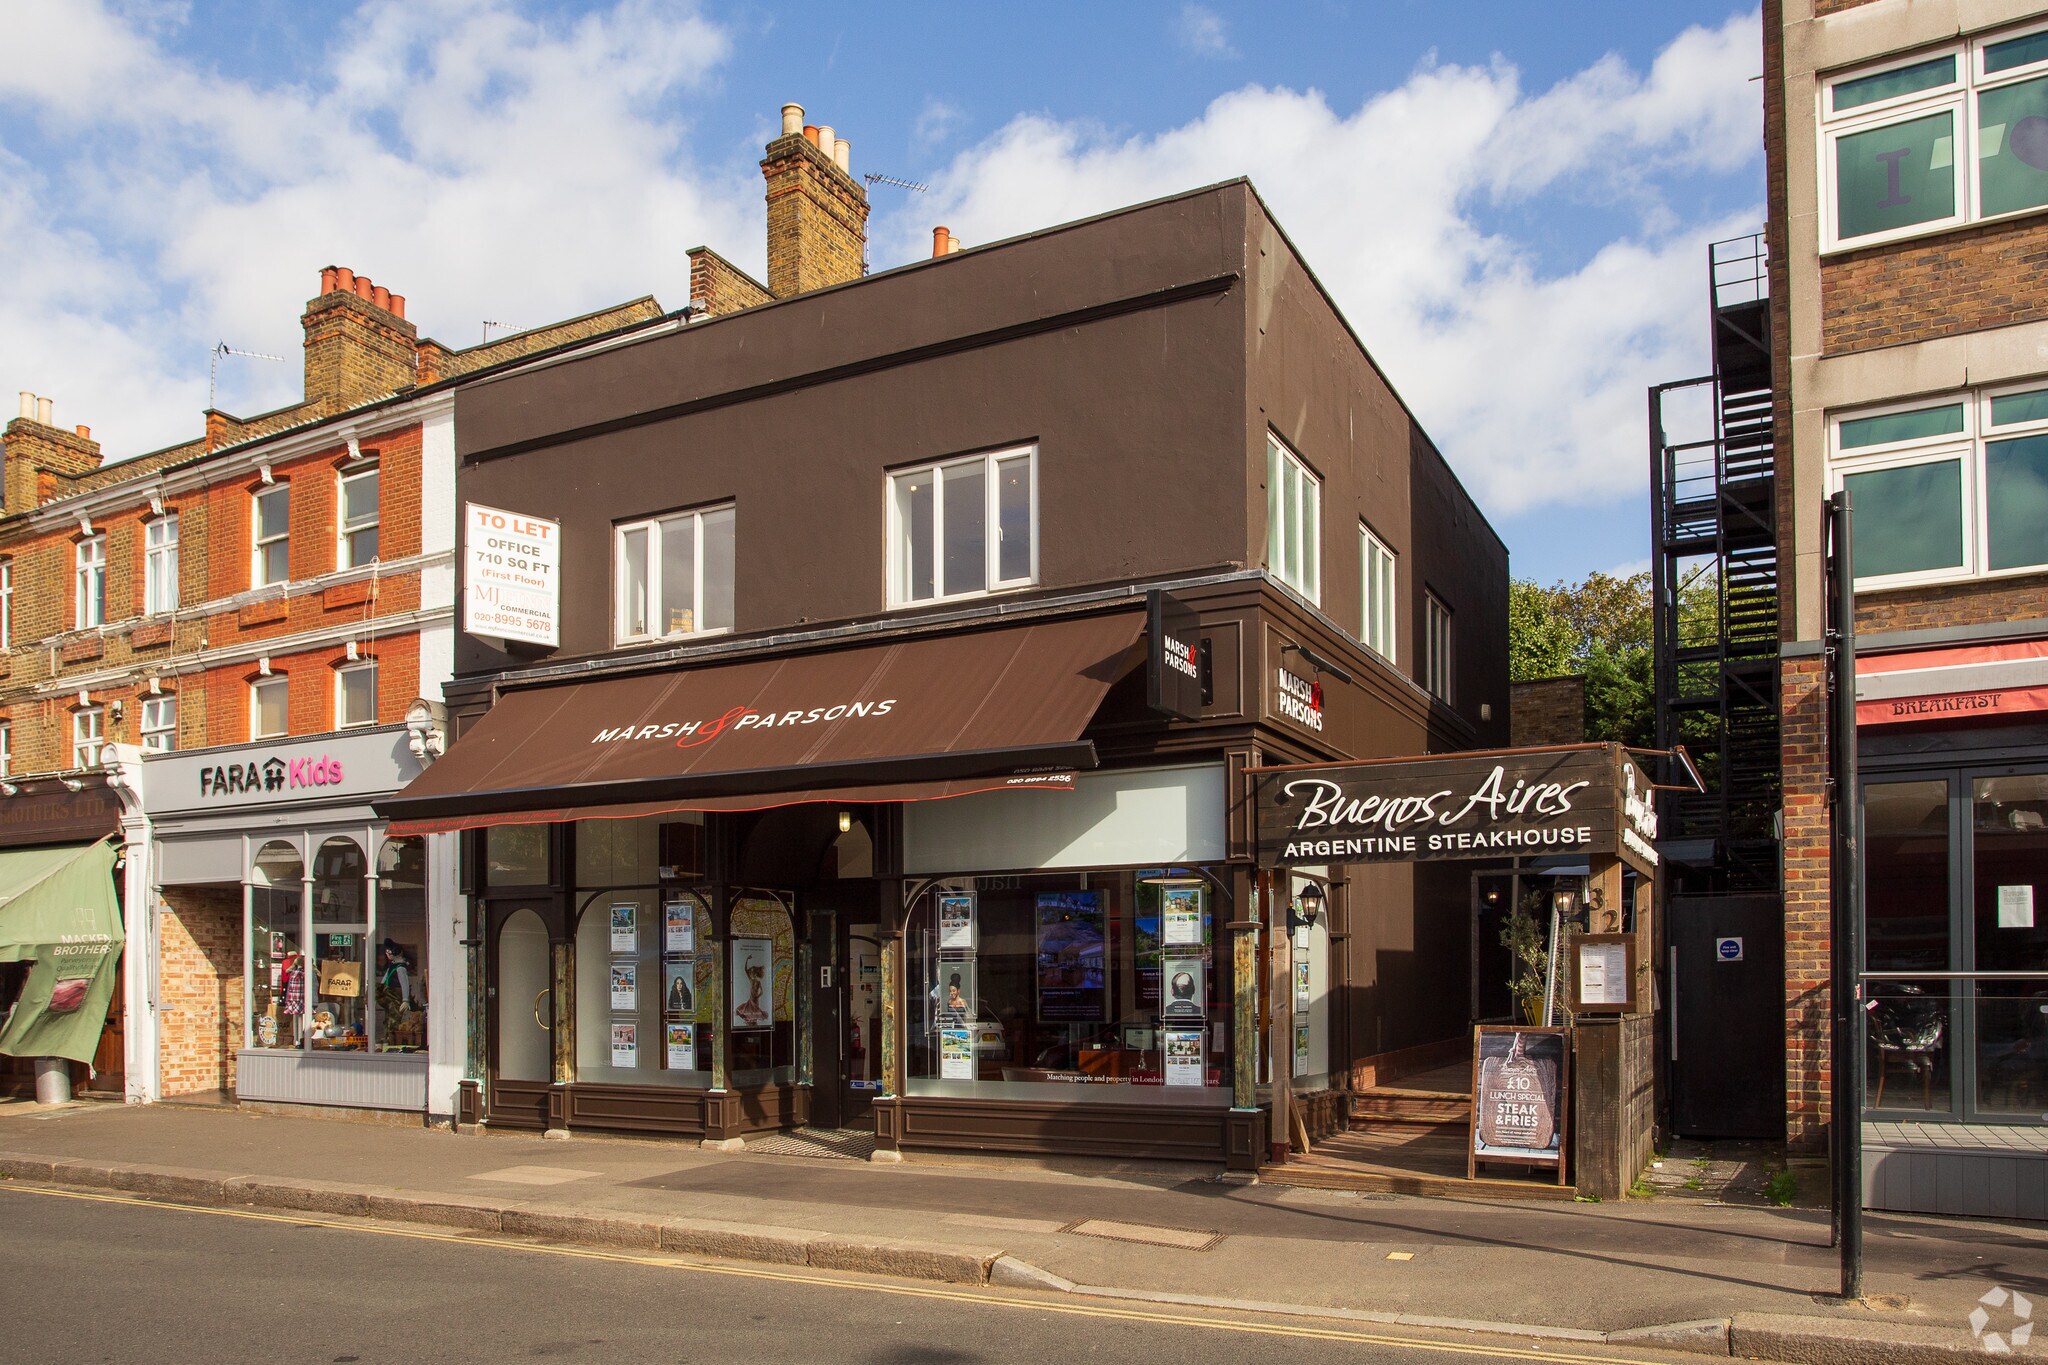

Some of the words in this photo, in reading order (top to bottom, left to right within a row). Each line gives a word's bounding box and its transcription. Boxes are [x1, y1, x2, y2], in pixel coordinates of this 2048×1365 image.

[477, 511, 506, 530] TO
[513, 519, 551, 539] LET
[487, 537, 541, 557] OFFICE
[476, 551, 502, 565] 710
[507, 557, 528, 571] SQ
[532, 562, 550, 574] FT
[481, 568, 511, 581] (First
[514, 574, 545, 588] Floor)
[500, 604, 552, 619] COMMERCIAL
[526, 618, 551, 632] 5678
[1164, 634, 1190, 660] MARSH
[1164, 651, 1197, 679] PARSONS
[1278, 667, 1312, 705] MARSH
[1278, 691, 1323, 732] PARSONS
[1892, 694, 2001, 716] BREAKFAST
[591, 720, 702, 744] MARSH
[734, 699, 897, 731] PARSONS
[200, 761, 262, 797] FARA
[288, 754, 344, 788] Kids
[75, 798, 105, 818] LTD
[1283, 779, 1451, 831] Buenos
[1438, 765, 1590, 826] Aires
[1283, 835, 1416, 858] ARGENTINE
[1428, 826, 1591, 851] STEAKHOUSE
[61, 933, 112, 944] MACKEN
[327, 978, 346, 986] FARA
[1046, 1073, 1073, 1082] Matching
[1074, 1074, 1093, 1083] people
[1094, 1074, 1105, 1082] and
[1105, 1075, 1131, 1084] property
[1139, 1075, 1164, 1083] London
[1506, 1077, 1530, 1090] £10
[1490, 1091, 1516, 1100] LUNCH
[1517, 1094, 1546, 1102] SPECIAL
[1497, 1103, 1538, 1115] STEAK
[1495, 1114, 1538, 1127] &FRIES
